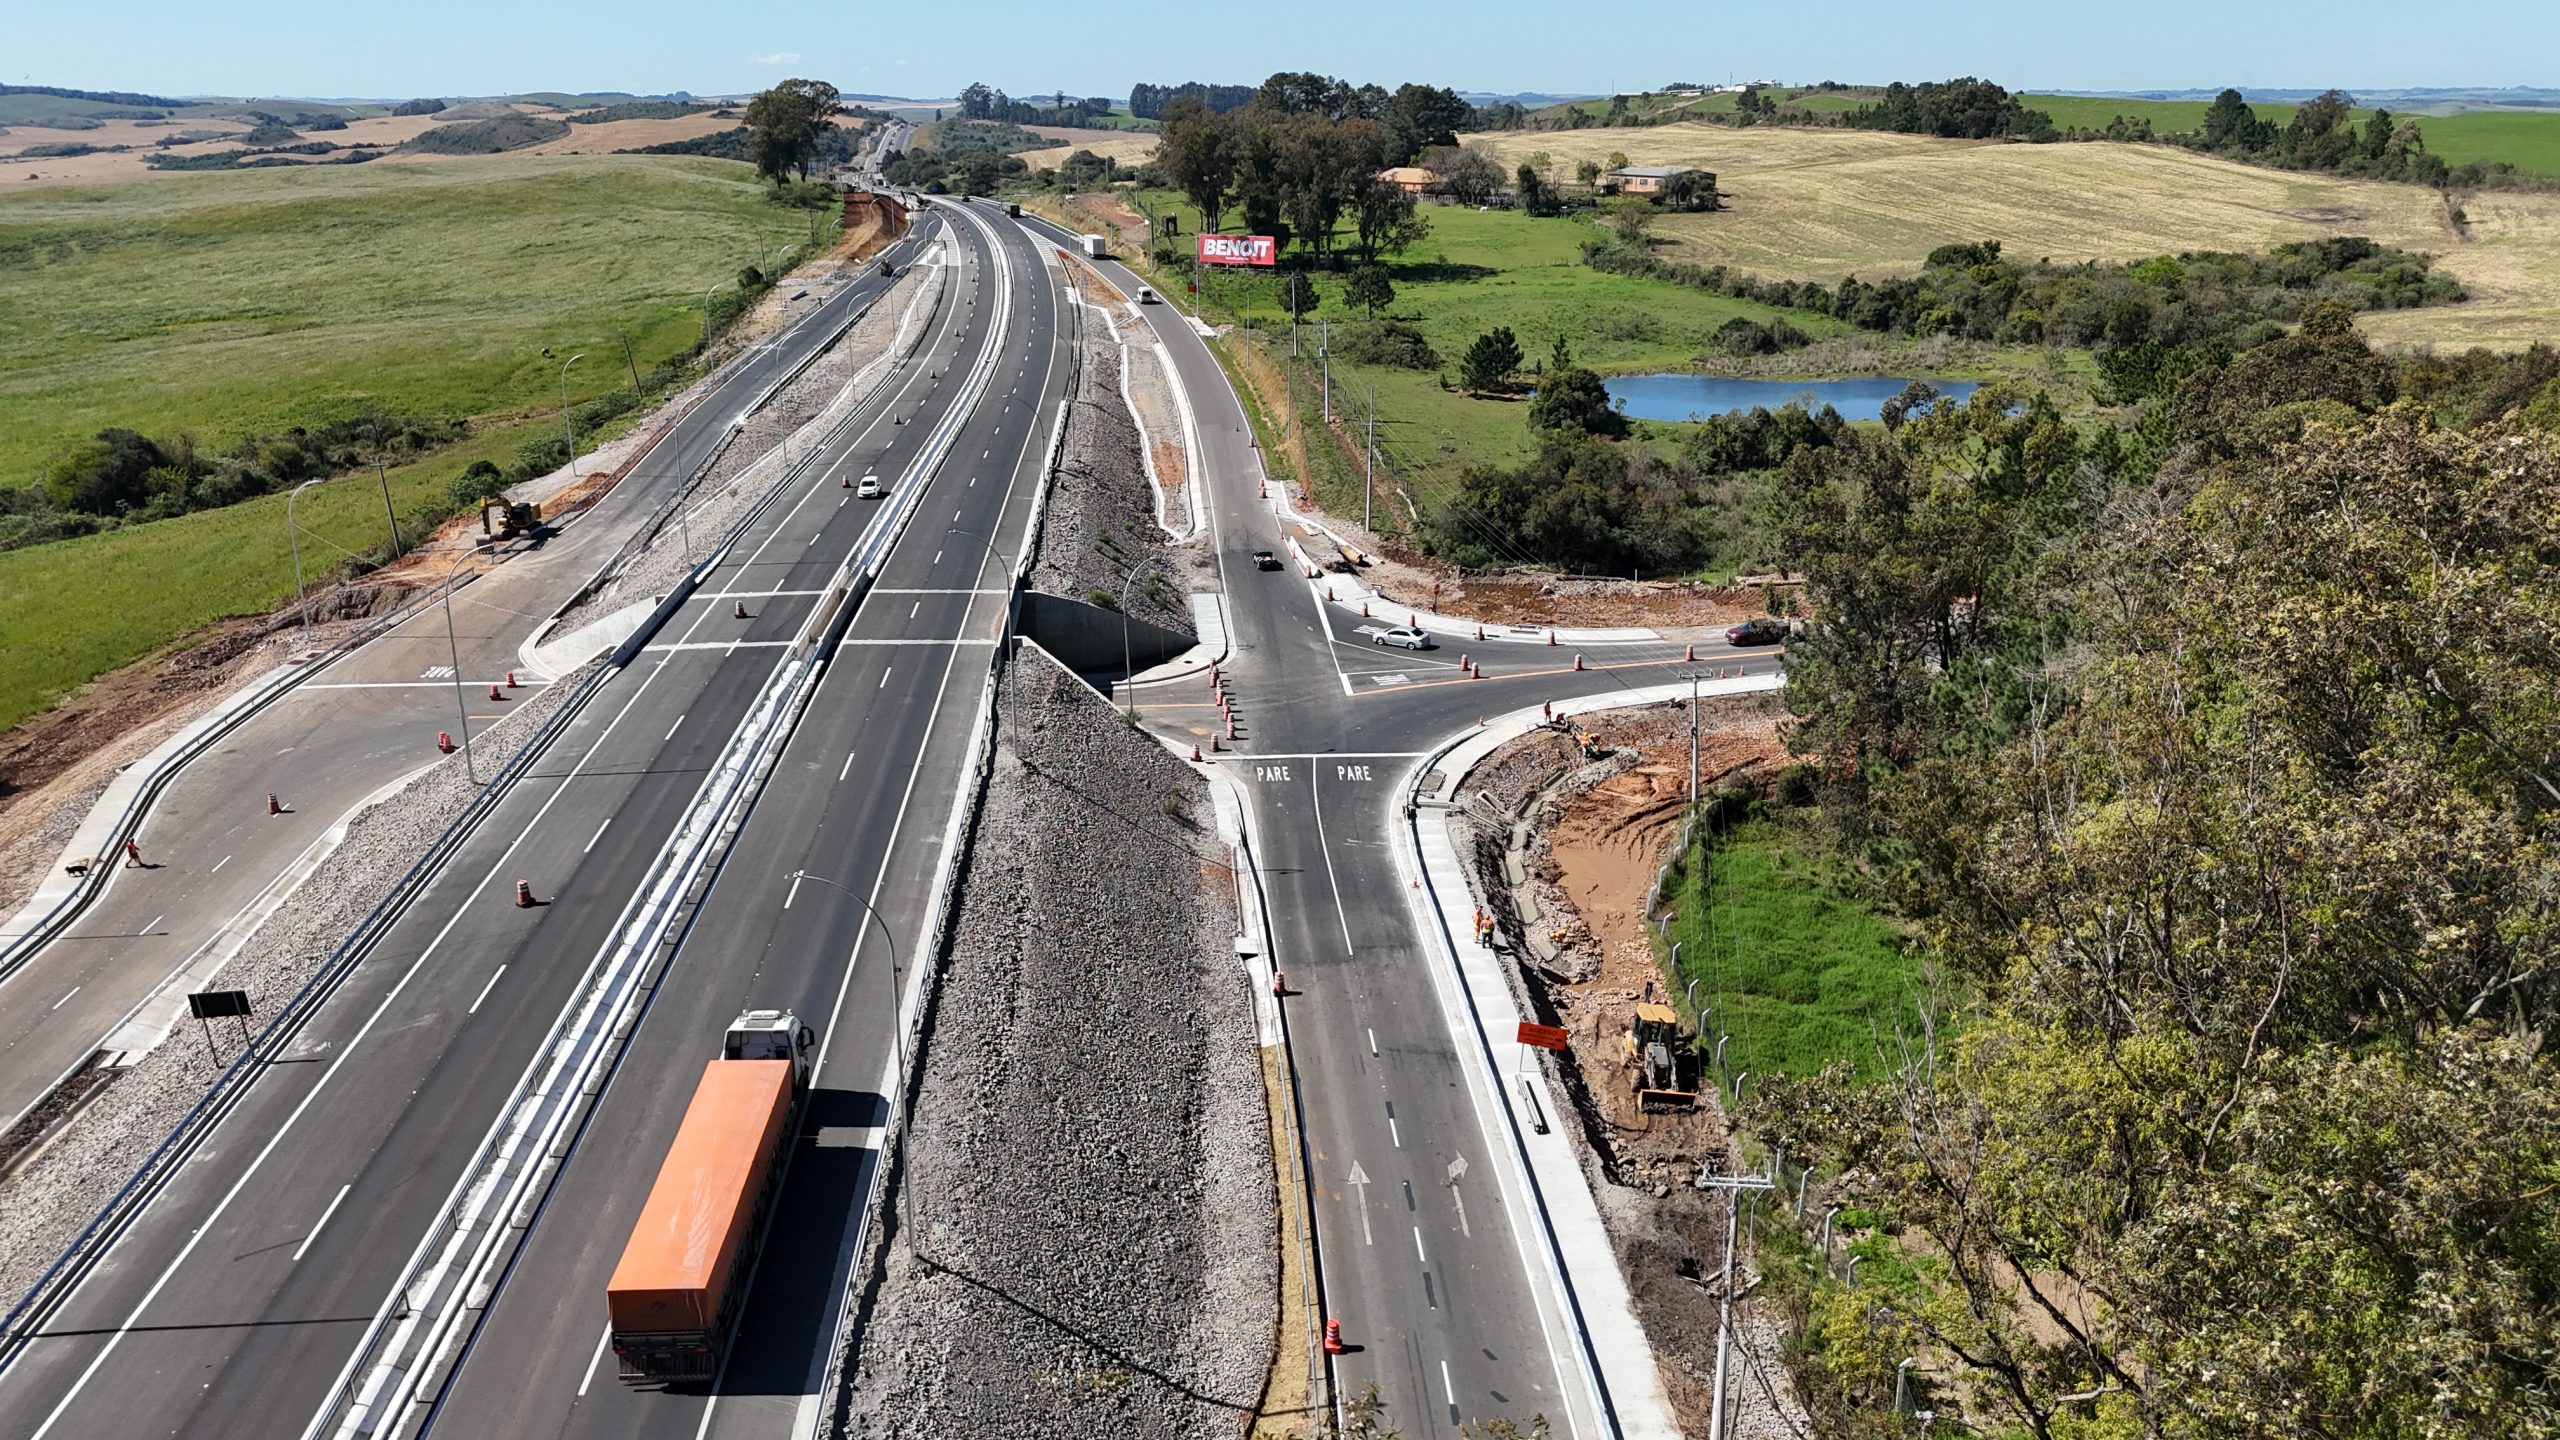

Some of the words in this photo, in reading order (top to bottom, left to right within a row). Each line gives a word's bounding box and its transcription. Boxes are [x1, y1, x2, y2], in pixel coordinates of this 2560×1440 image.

[1203, 239, 1271, 257] BENOIT
[1256, 766, 1291, 782] PARE
[1337, 765, 1372, 781] PARE
